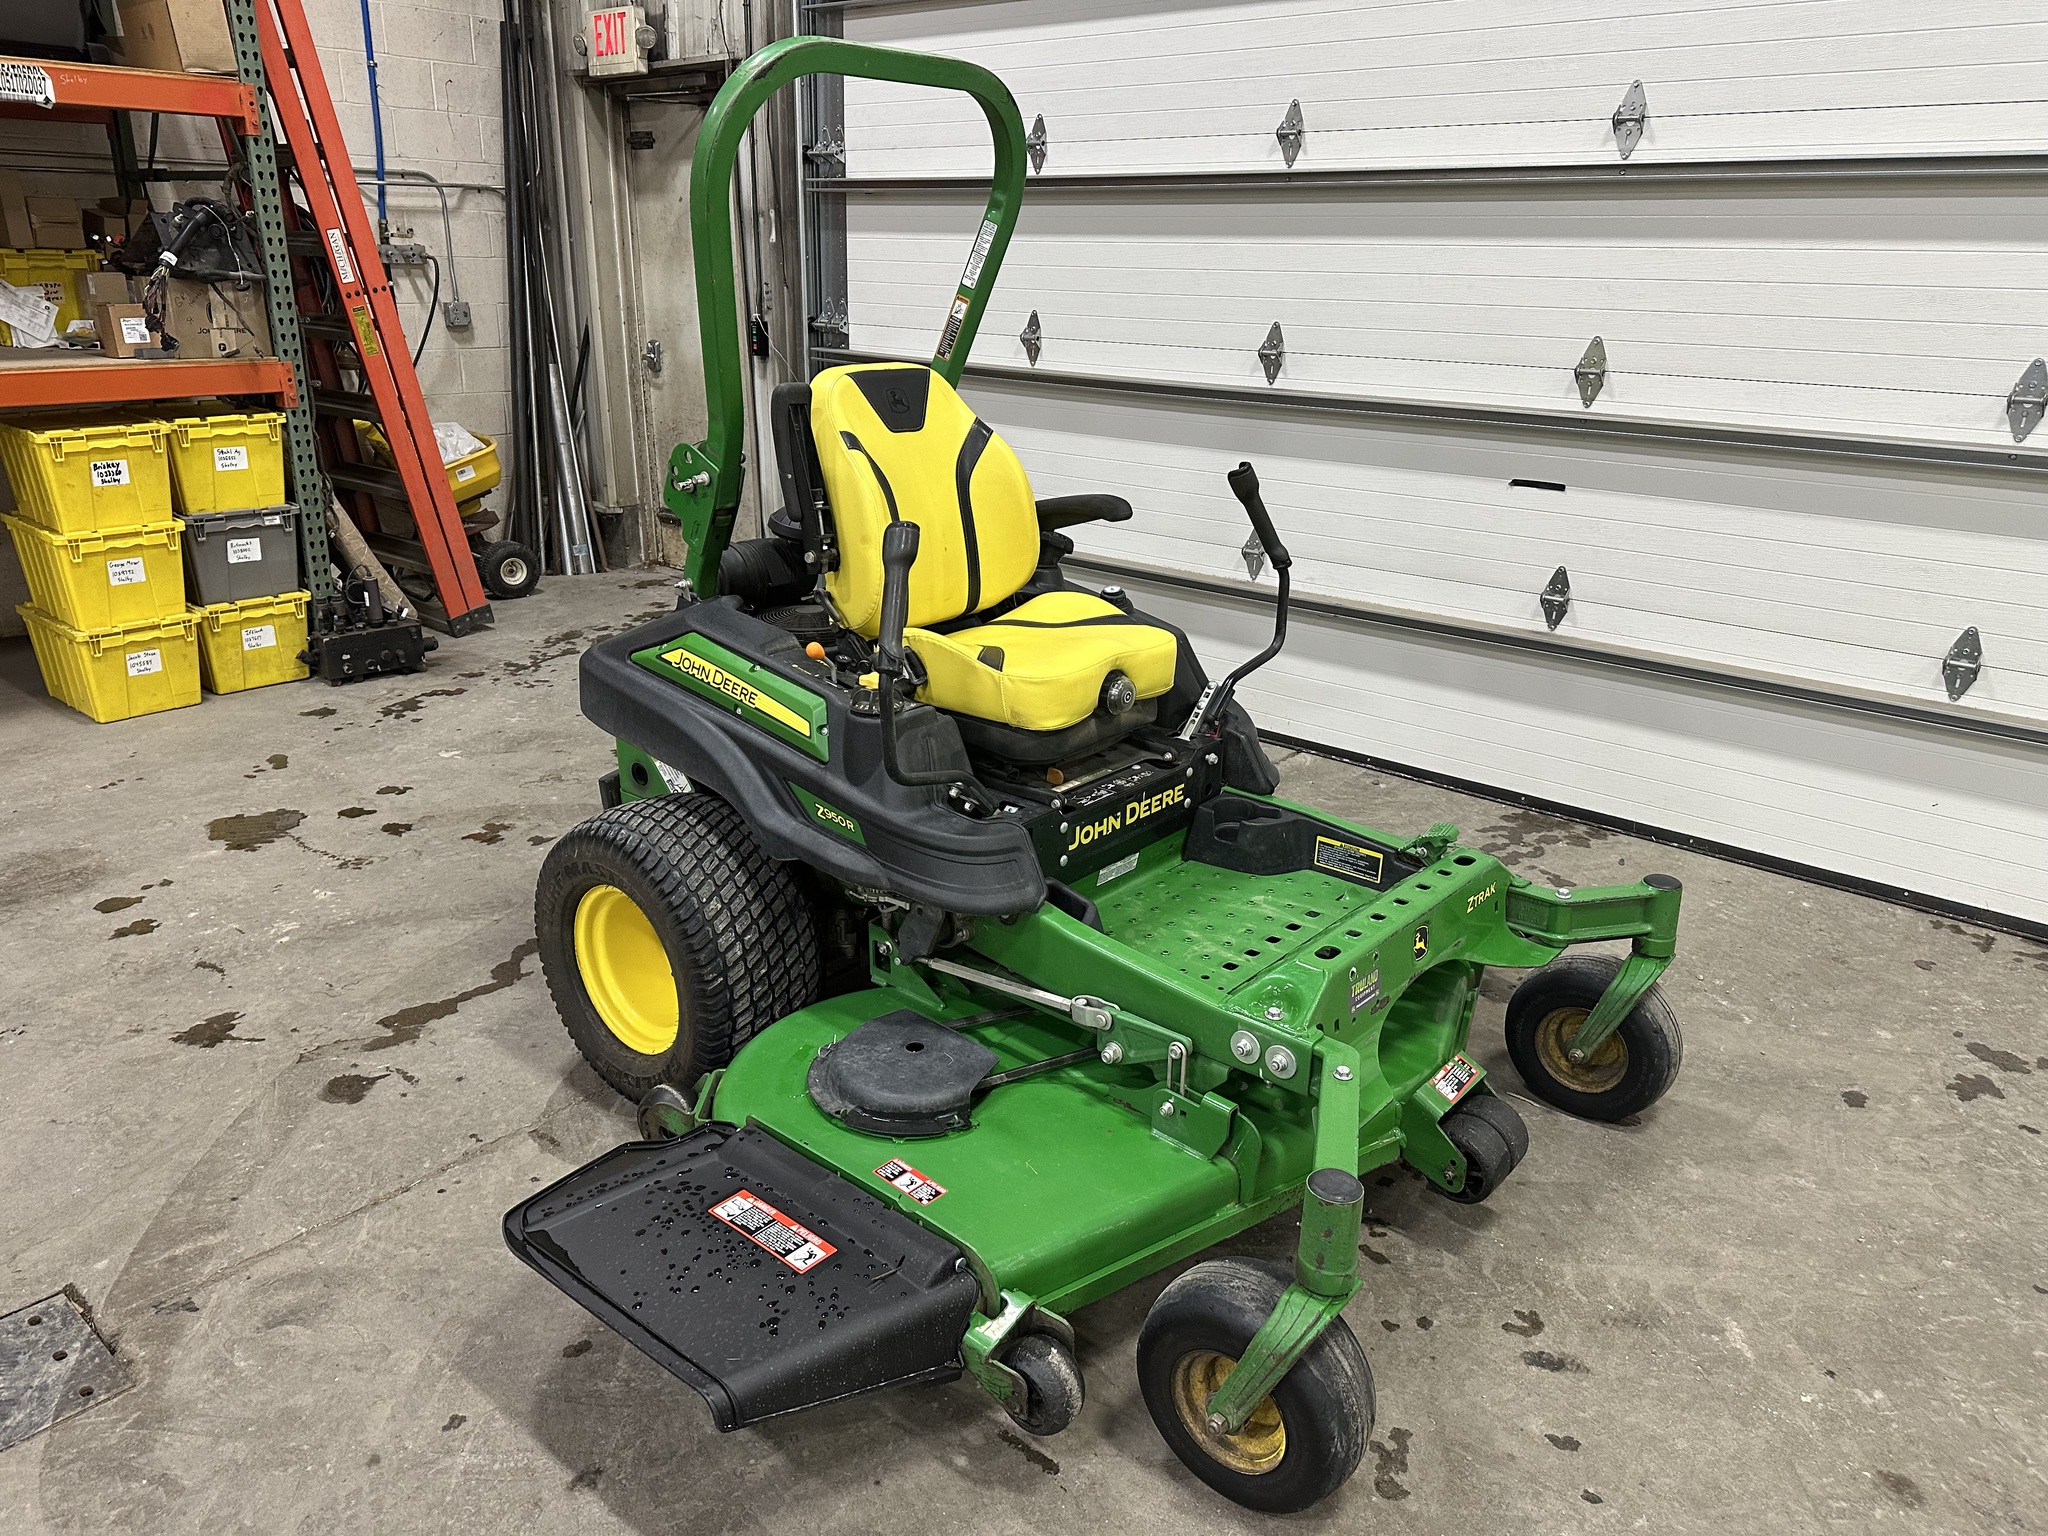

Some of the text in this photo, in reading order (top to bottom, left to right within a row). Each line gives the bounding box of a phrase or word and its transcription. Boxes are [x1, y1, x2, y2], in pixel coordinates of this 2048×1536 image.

[594, 12, 626, 56] EXIT
[330, 232, 349, 280] MICHIGAN
[101, 477, 120, 485] Shelby
[673, 651, 758, 706] JOHN DEERE
[815, 803, 855, 832] Z950R
[1068, 813, 1121, 851] JOHN
[1126, 783, 1185, 825] DEERE
[1467, 881, 1496, 914] ZTRAK
[753, 1198, 776, 1216] DANGER
[798, 1226, 822, 1246] PELIGRO
